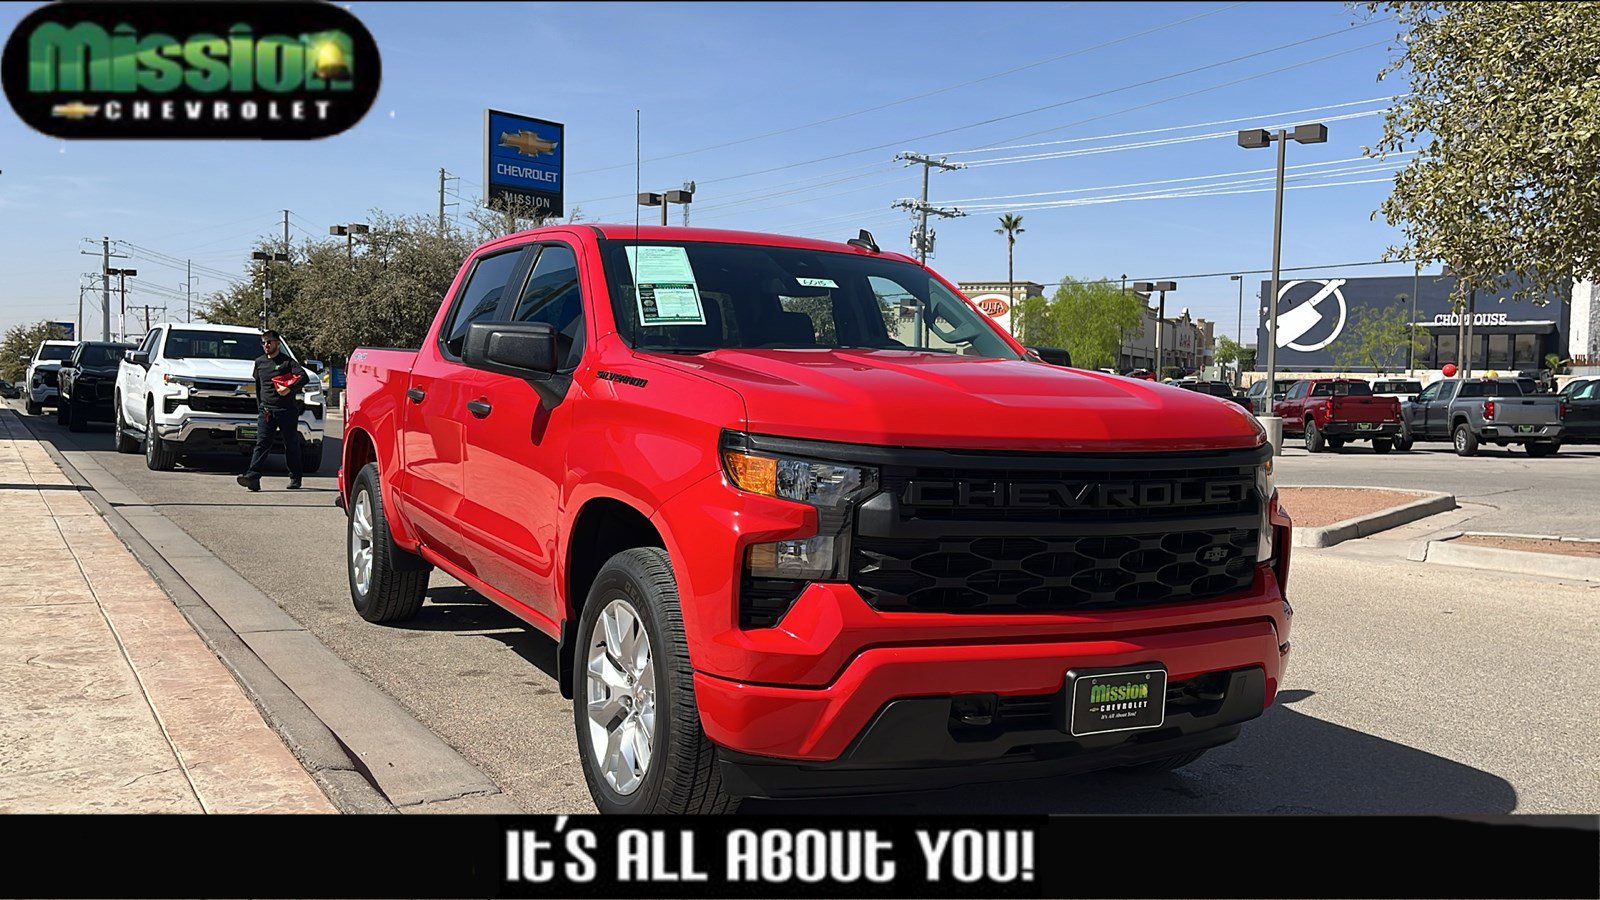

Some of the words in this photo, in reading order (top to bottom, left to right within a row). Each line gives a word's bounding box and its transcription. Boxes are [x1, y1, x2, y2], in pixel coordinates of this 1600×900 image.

[497, 163, 558, 183] CHEVROLET
[505, 191, 550, 208] MISSION
[980, 301, 1004, 312] ULTA
[596, 370, 648, 388] SILVERADO
[902, 480, 1248, 508] CHEVROLET
[1090, 682, 1148, 703] Mission
[1100, 701, 1148, 712] CHEVROLET
